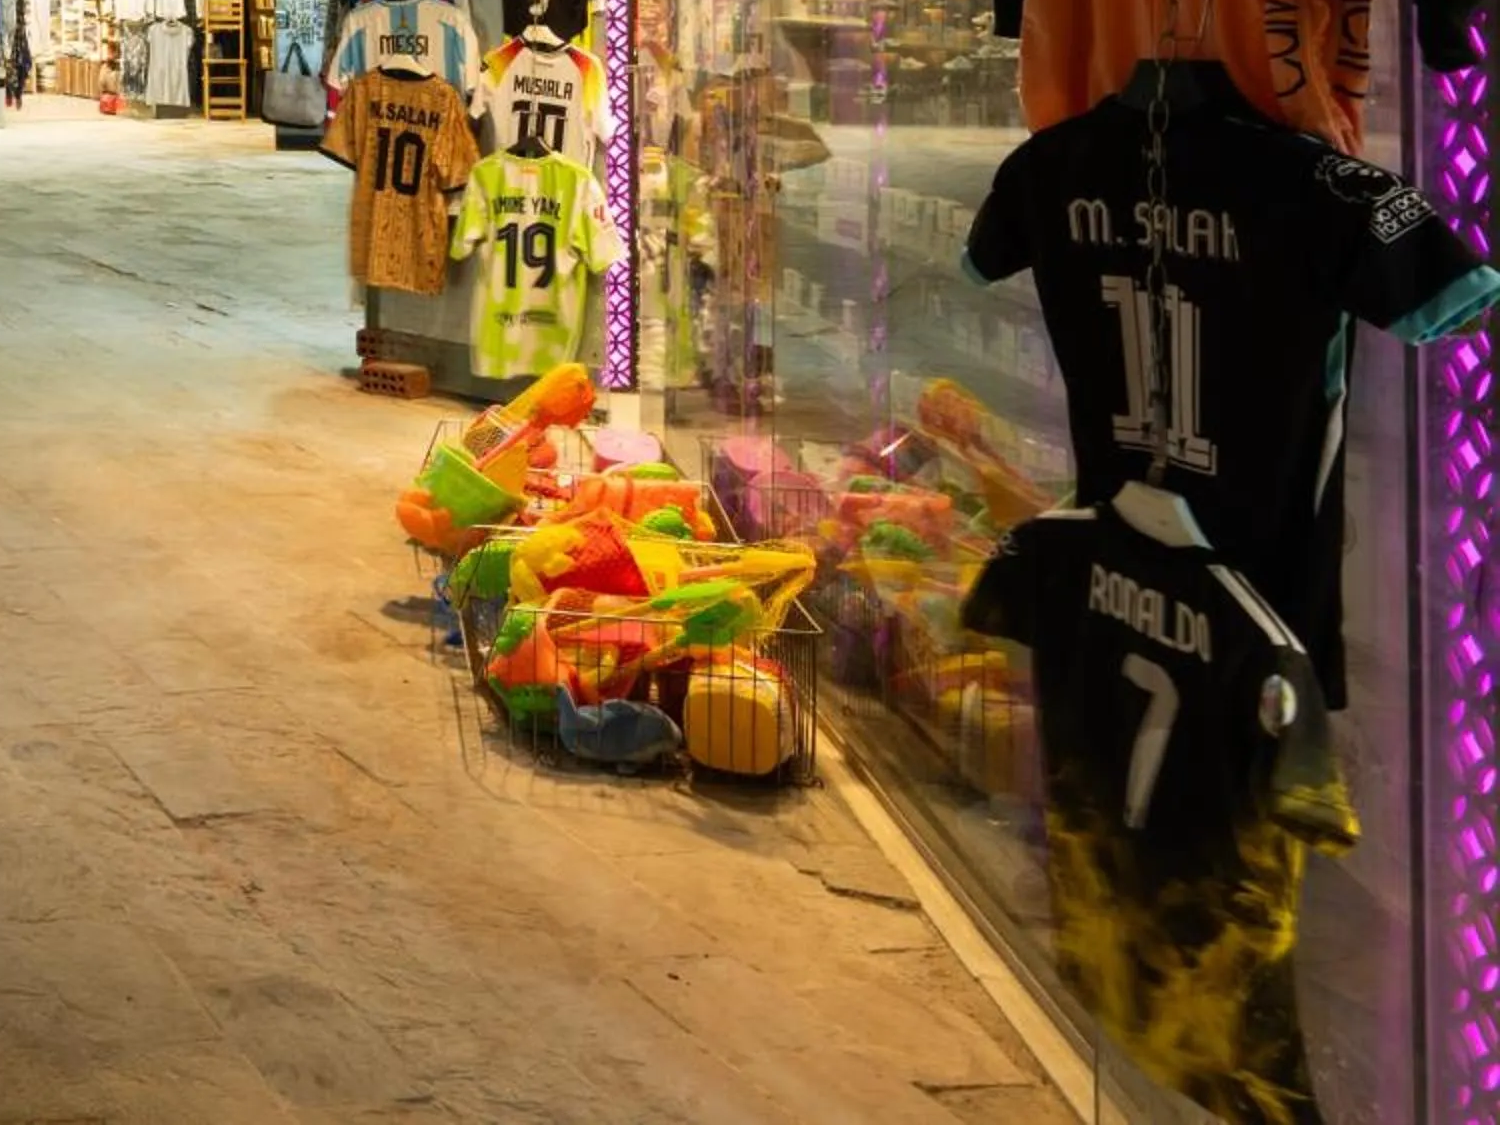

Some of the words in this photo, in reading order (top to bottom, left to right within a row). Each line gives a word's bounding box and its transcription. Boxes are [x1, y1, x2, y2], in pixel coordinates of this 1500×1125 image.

[379, 34, 430, 56] MESSI
[513, 74, 574, 102] MUSIALA
[374, 126, 427, 196] 10
[496, 222, 556, 289] 19
[1100, 275, 1218, 476] 11
[1089, 561, 1214, 663] RONALDO
[1121, 652, 1181, 830] 7
